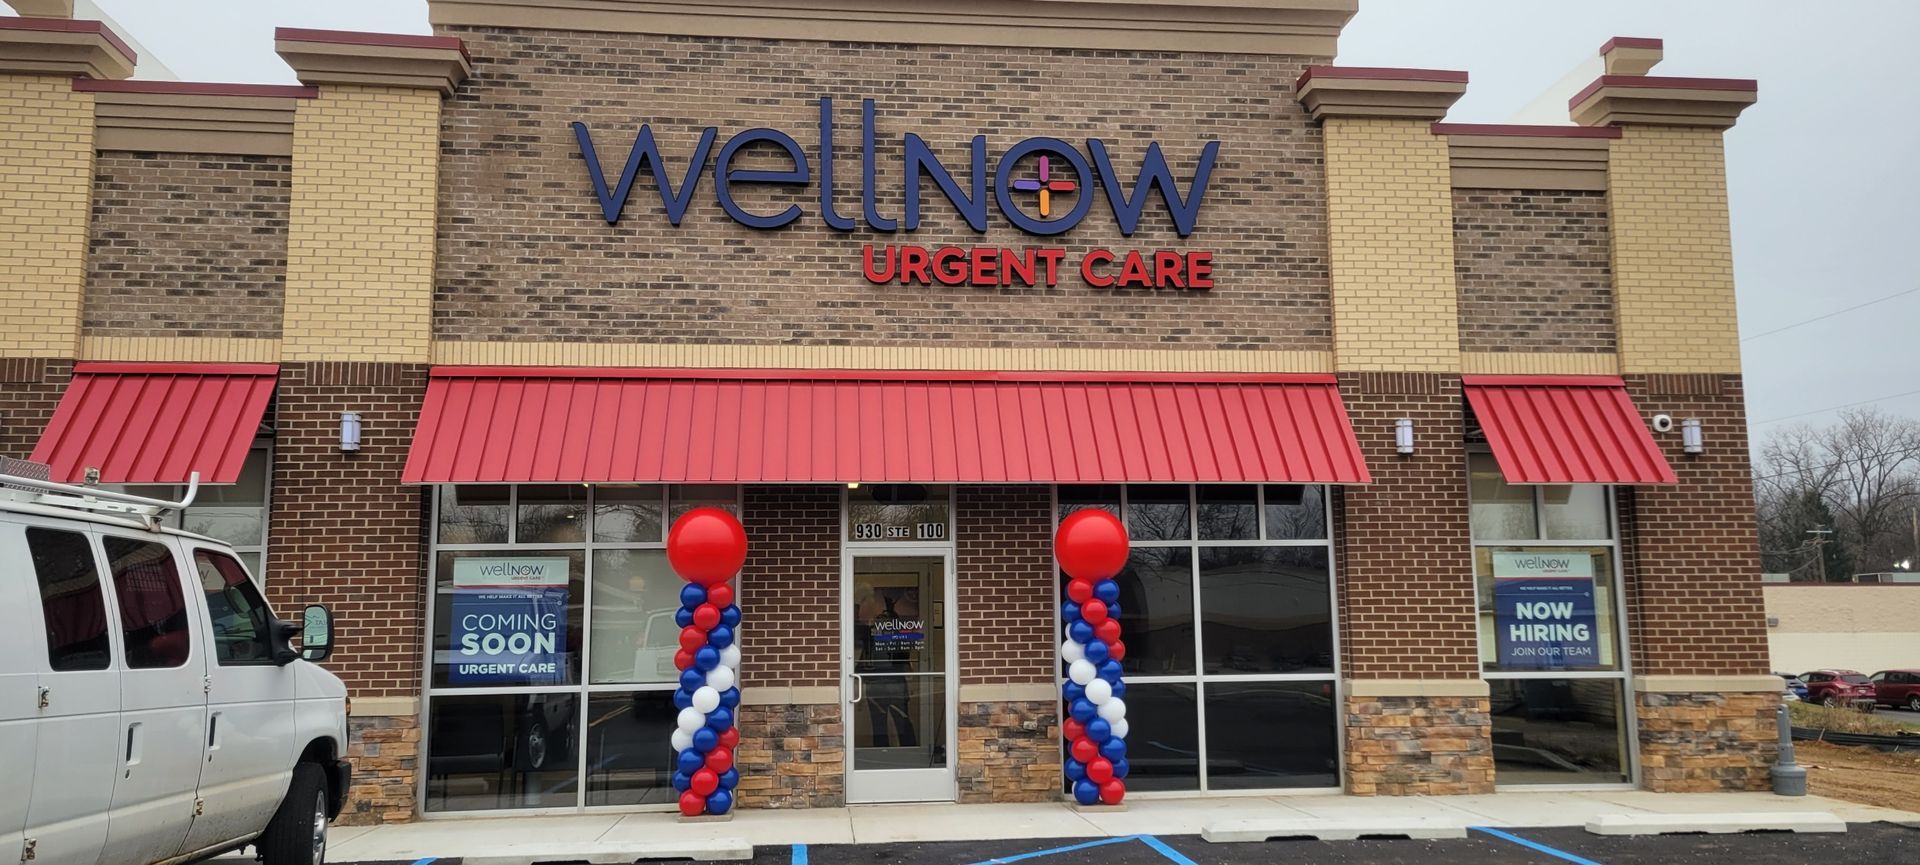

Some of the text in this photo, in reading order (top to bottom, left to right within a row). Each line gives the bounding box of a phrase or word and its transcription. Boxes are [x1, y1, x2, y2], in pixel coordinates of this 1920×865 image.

[863, 243, 1215, 290] URGENT CARE
[856, 523, 943, 538] 930 STE 100
[1515, 602, 1574, 620] NOW
[462, 613, 557, 631] COMING
[1509, 624, 1590, 642] HIRING
[460, 632, 556, 656] SOON
[1511, 646, 1592, 656] JOIN OUR TEAM
[459, 663, 556, 675] URGENT CARE
